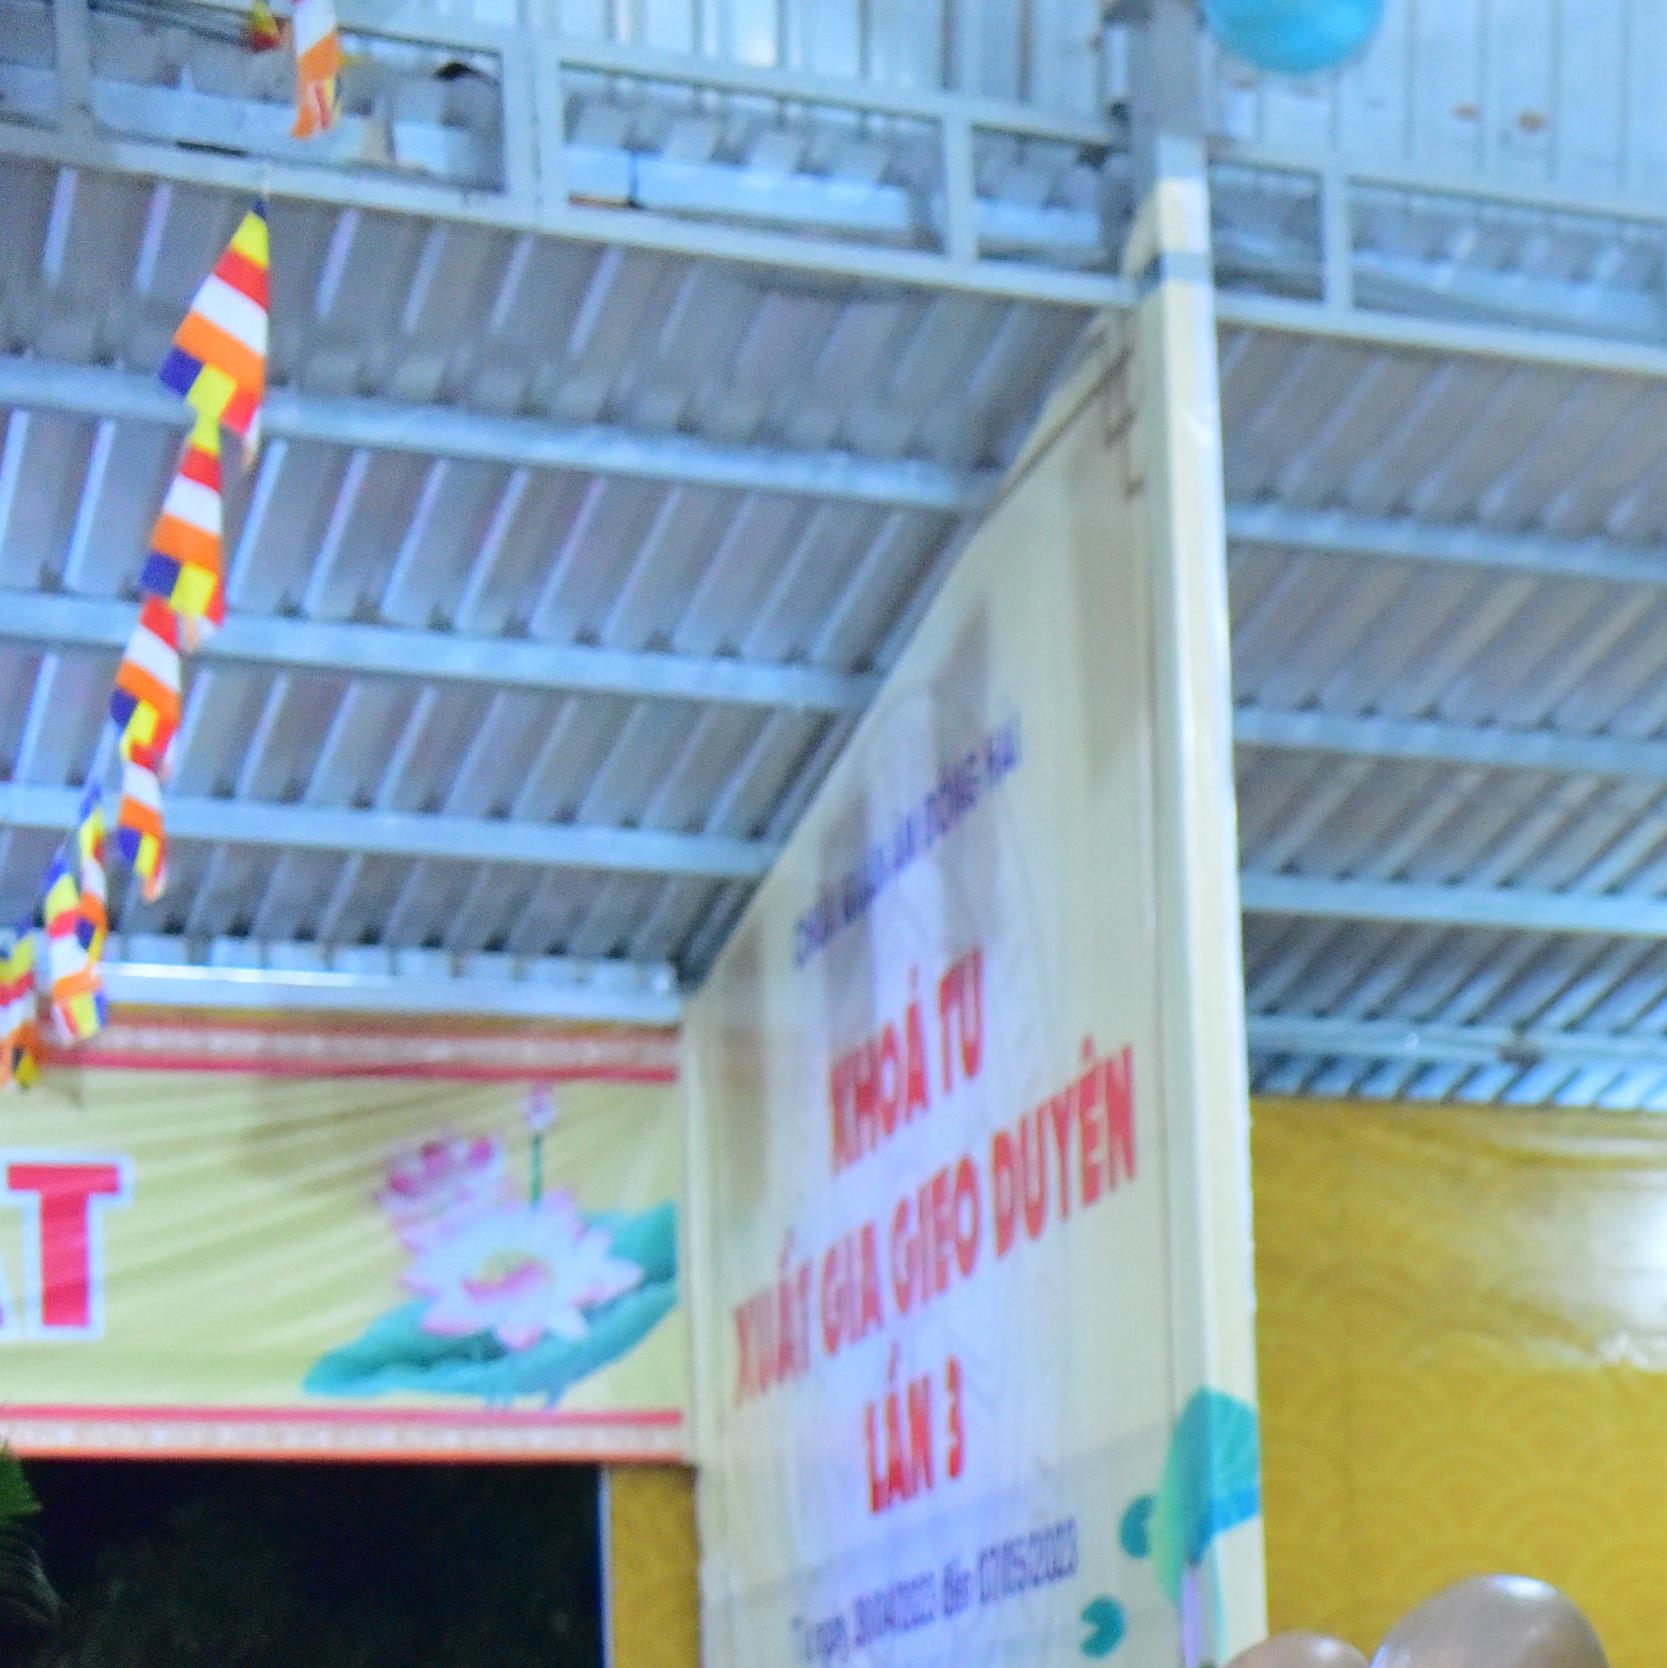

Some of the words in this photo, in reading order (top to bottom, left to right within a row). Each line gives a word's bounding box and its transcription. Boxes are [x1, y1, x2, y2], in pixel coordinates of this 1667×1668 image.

[829, 962, 930, 1177] KHOÁ
[939, 944, 984, 1096] TU
[0, 1162, 121, 1328] T
[731, 1225, 814, 1410] XUẤT
[820, 1219, 886, 1358] GIA
[890, 1154, 980, 1314] GIEO
[990, 1033, 1136, 1260] DUYÊN
[944, 1356, 965, 1480] 3
